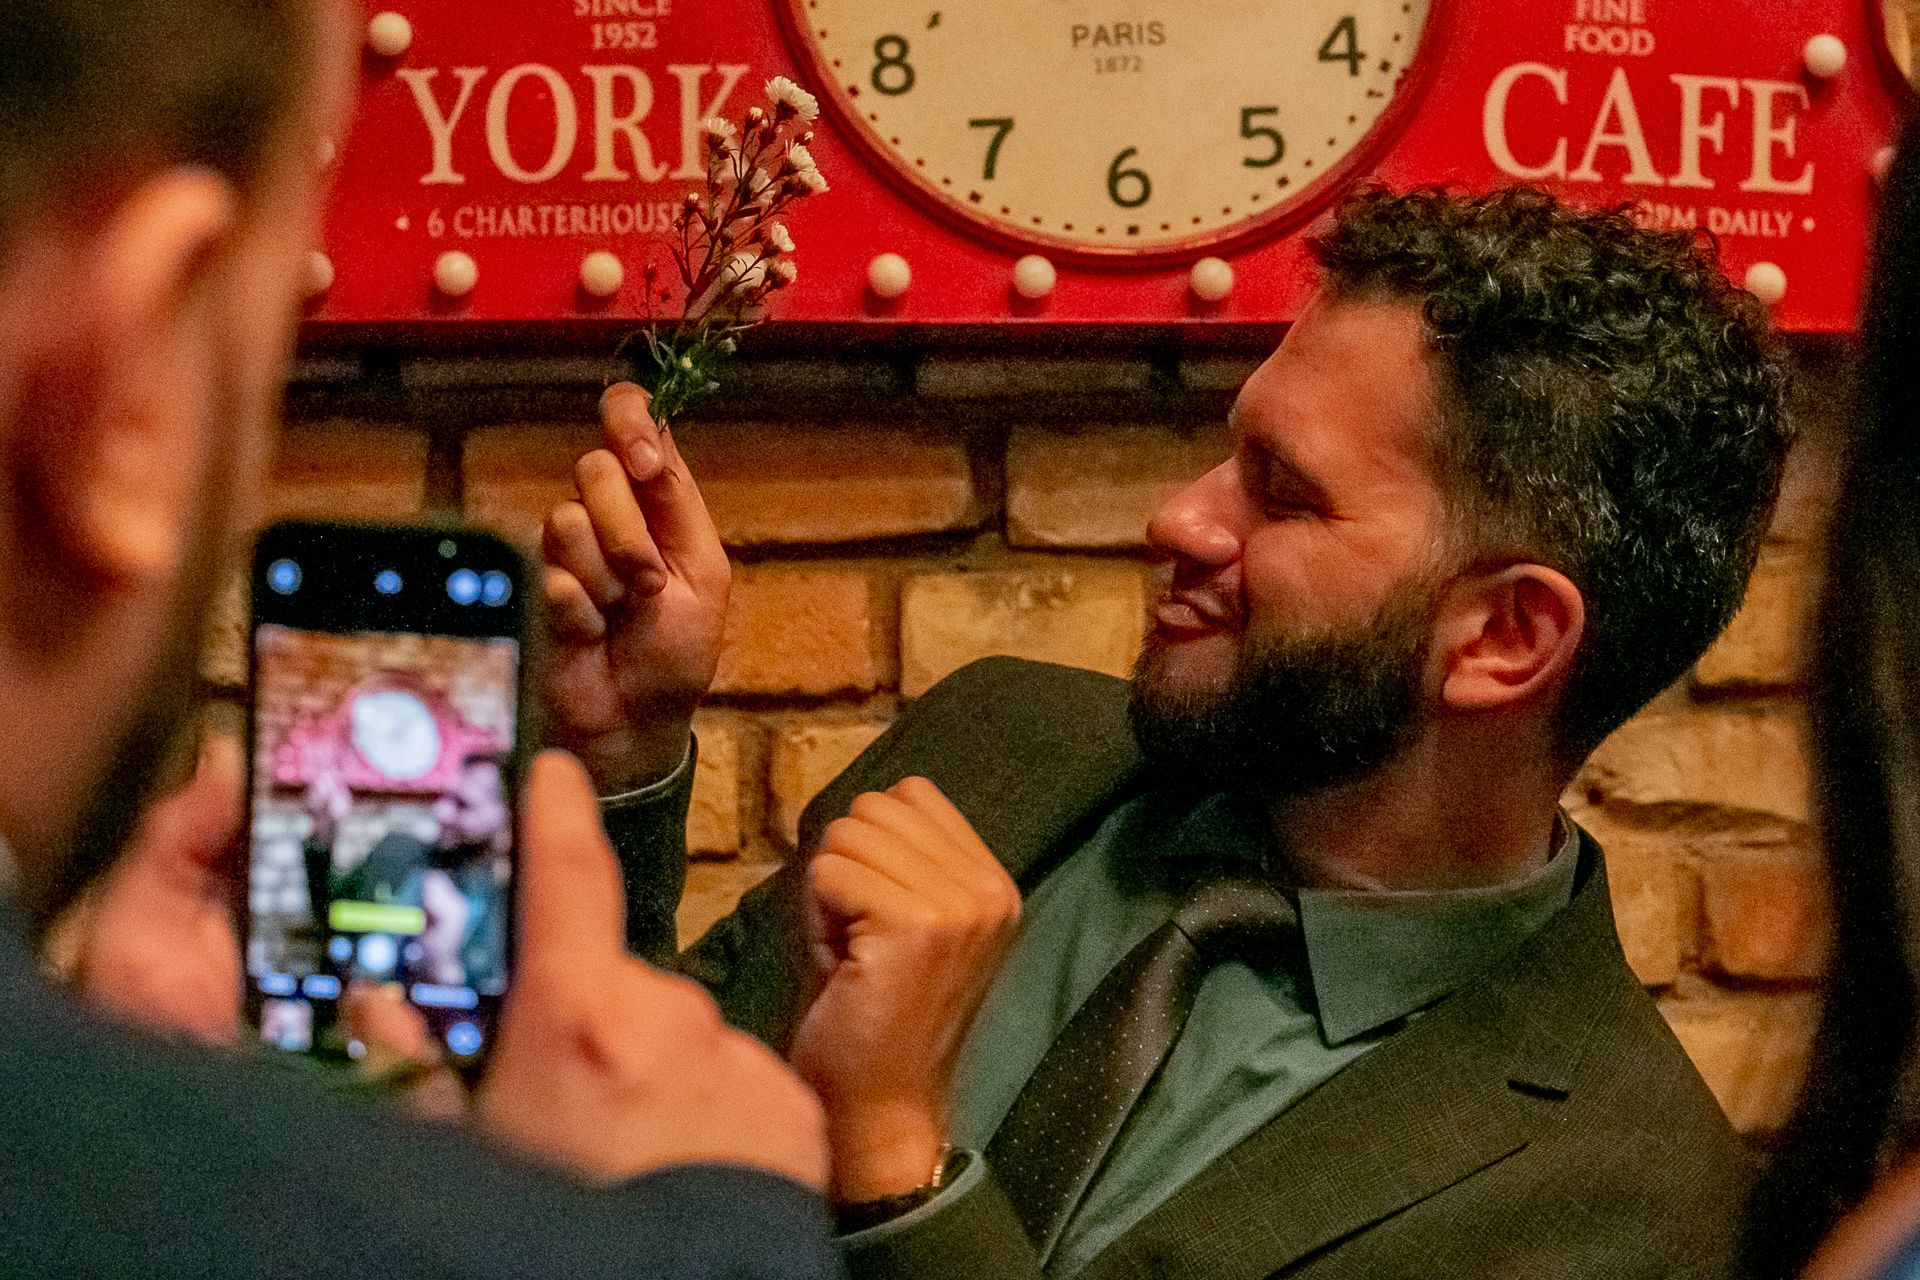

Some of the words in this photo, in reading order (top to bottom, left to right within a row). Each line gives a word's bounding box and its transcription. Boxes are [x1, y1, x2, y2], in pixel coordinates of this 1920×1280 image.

[591, 22, 658, 50] 1952
[870, 34, 915, 95] 8
[1071, 20, 1167, 48] PARIS
[1317, 15, 1367, 76] 4
[1564, 25, 1656, 56] FOOD
[396, 62, 752, 184] YORK
[968, 117, 1014, 180] 7
[1238, 106, 1285, 168] 5
[1482, 61, 1815, 195] CAFE
[1106, 147, 1152, 208] 6
[427, 208, 445, 238] 6
[1708, 206, 1794, 238] DAILY
